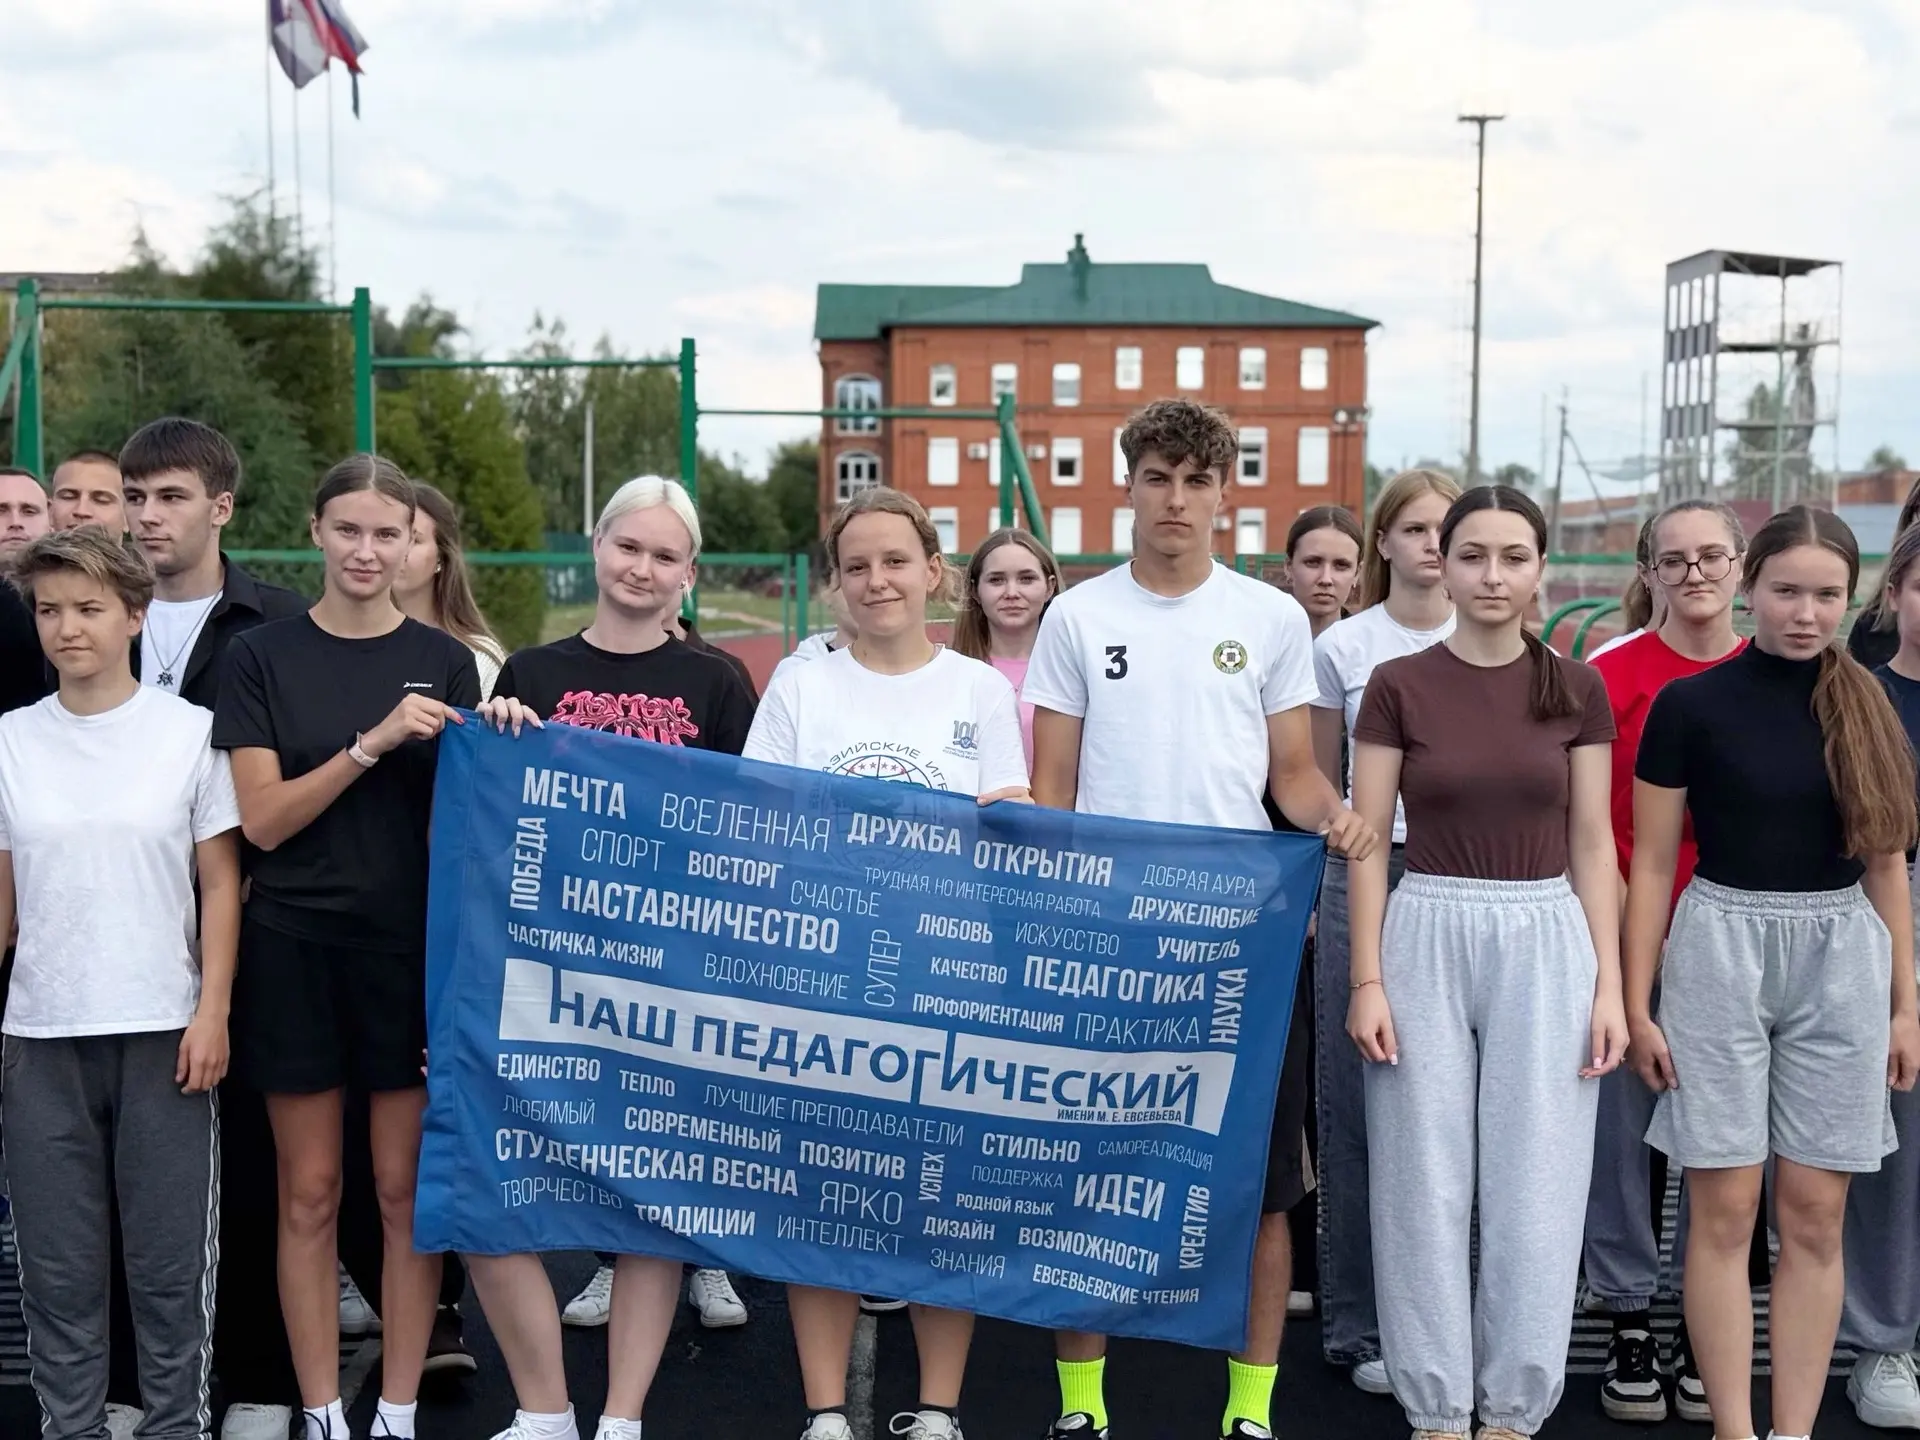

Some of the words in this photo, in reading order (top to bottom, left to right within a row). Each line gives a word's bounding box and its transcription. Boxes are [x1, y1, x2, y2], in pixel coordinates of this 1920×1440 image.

[1105, 645, 1128, 680] 3
[523, 767, 626, 819] МЕЧТА
[661, 793, 830, 852] ВСЕЛЕННАЯ
[847, 812, 961, 855] ДРУЖБА
[510, 818, 548, 910] ПОБЕДА
[582, 828, 665, 871] СПОРТ
[974, 840, 1113, 887] ОТКРЫТИЯ
[688, 851, 784, 888] ВОСТОРГ
[1141, 864, 1208, 892] ДОБРАЯ
[1212, 874, 1255, 898] АУРА
[562, 875, 839, 953] НАСТАВНИЧЕСТВО
[791, 880, 881, 917] СЧАСТЬЕ
[935, 878, 953, 896] НО
[956, 881, 1043, 909] ИНТЕРЕСНАЯ
[1046, 894, 1100, 917] РАБОТА
[1128, 896, 1262, 928] ДРУЖЕЛЮБИЕ
[508, 922, 595, 956] ЧАСТИЧКА
[601, 939, 663, 969] ЖИЗНИ
[916, 914, 992, 943] ЛЮБОВЬ
[1015, 922, 1119, 956] ИСКУССТВО
[864, 930, 901, 1007] СУПЕР
[1157, 936, 1240, 963] УЧИТЕЛЬ
[704, 953, 849, 999] ВДОХНОВЕНИЕ
[931, 957, 1007, 984] КАЧЕСТВО
[1024, 955, 1205, 1003] ПЕДАГОГИКА
[913, 993, 1064, 1033] ПРОФОРИЕНТАЦИЯ
[1209, 968, 1248, 1044] НАУКА
[549, 967, 676, 1048] НАШ
[692, 1014, 1200, 1126] ПЕДАГОГИЧЕСКИЙ
[1075, 1013, 1199, 1045] ПРАКТИКА
[498, 1054, 600, 1081] ЕДИНСТВО
[619, 1070, 675, 1097] ТЕПЛО
[504, 1095, 595, 1124] ЛЮБИМЫЙ
[704, 1085, 786, 1119] ЛУЧШИЕ
[792, 1099, 963, 1146] ПРЕПОДАВАТЕЛИ
[1057, 1108, 1094, 1121] ИМЕНИ
[1123, 1109, 1182, 1123] ЕВСЕВЬЕВА
[625, 1107, 781, 1153] СОВРЕМЕННЫЙ
[982, 1133, 1080, 1162] СТИЛЬНО
[496, 1128, 704, 1182] СТУДЕНЧЕСКАЯ
[713, 1157, 798, 1196] ВЕСНА
[800, 1141, 905, 1180] ПОЗИТИВ
[1098, 1141, 1212, 1171] САМОРЕАЛИЗАЦИЯ
[501, 1174, 622, 1208] ТВОРЧЕСТВО
[919, 1152, 945, 1202] УСПЕХ
[972, 1165, 1063, 1188] ПОДДЕРЖКА
[820, 1181, 902, 1225] ЯРКО
[956, 1193, 1011, 1212] РОДНОЙ
[1014, 1200, 1054, 1215] ЯЗЫК
[1074, 1174, 1165, 1221] ИДЕИ
[635, 1204, 755, 1237] ТРАДИЦИИ
[777, 1215, 902, 1255] ИНТЕЛЛЕКТ
[923, 1216, 995, 1240] ДИЗАЙН
[1179, 1185, 1210, 1268] КРЕАТИВ
[931, 1248, 1005, 1279] ЗНАНИЯ
[1018, 1227, 1159, 1276] ВОЗМОЖНОСТИ
[1033, 1264, 1139, 1304] ЕВСЕВЬЕВСКИЕ
[1143, 1288, 1199, 1304] ЧТЕНИЯ
